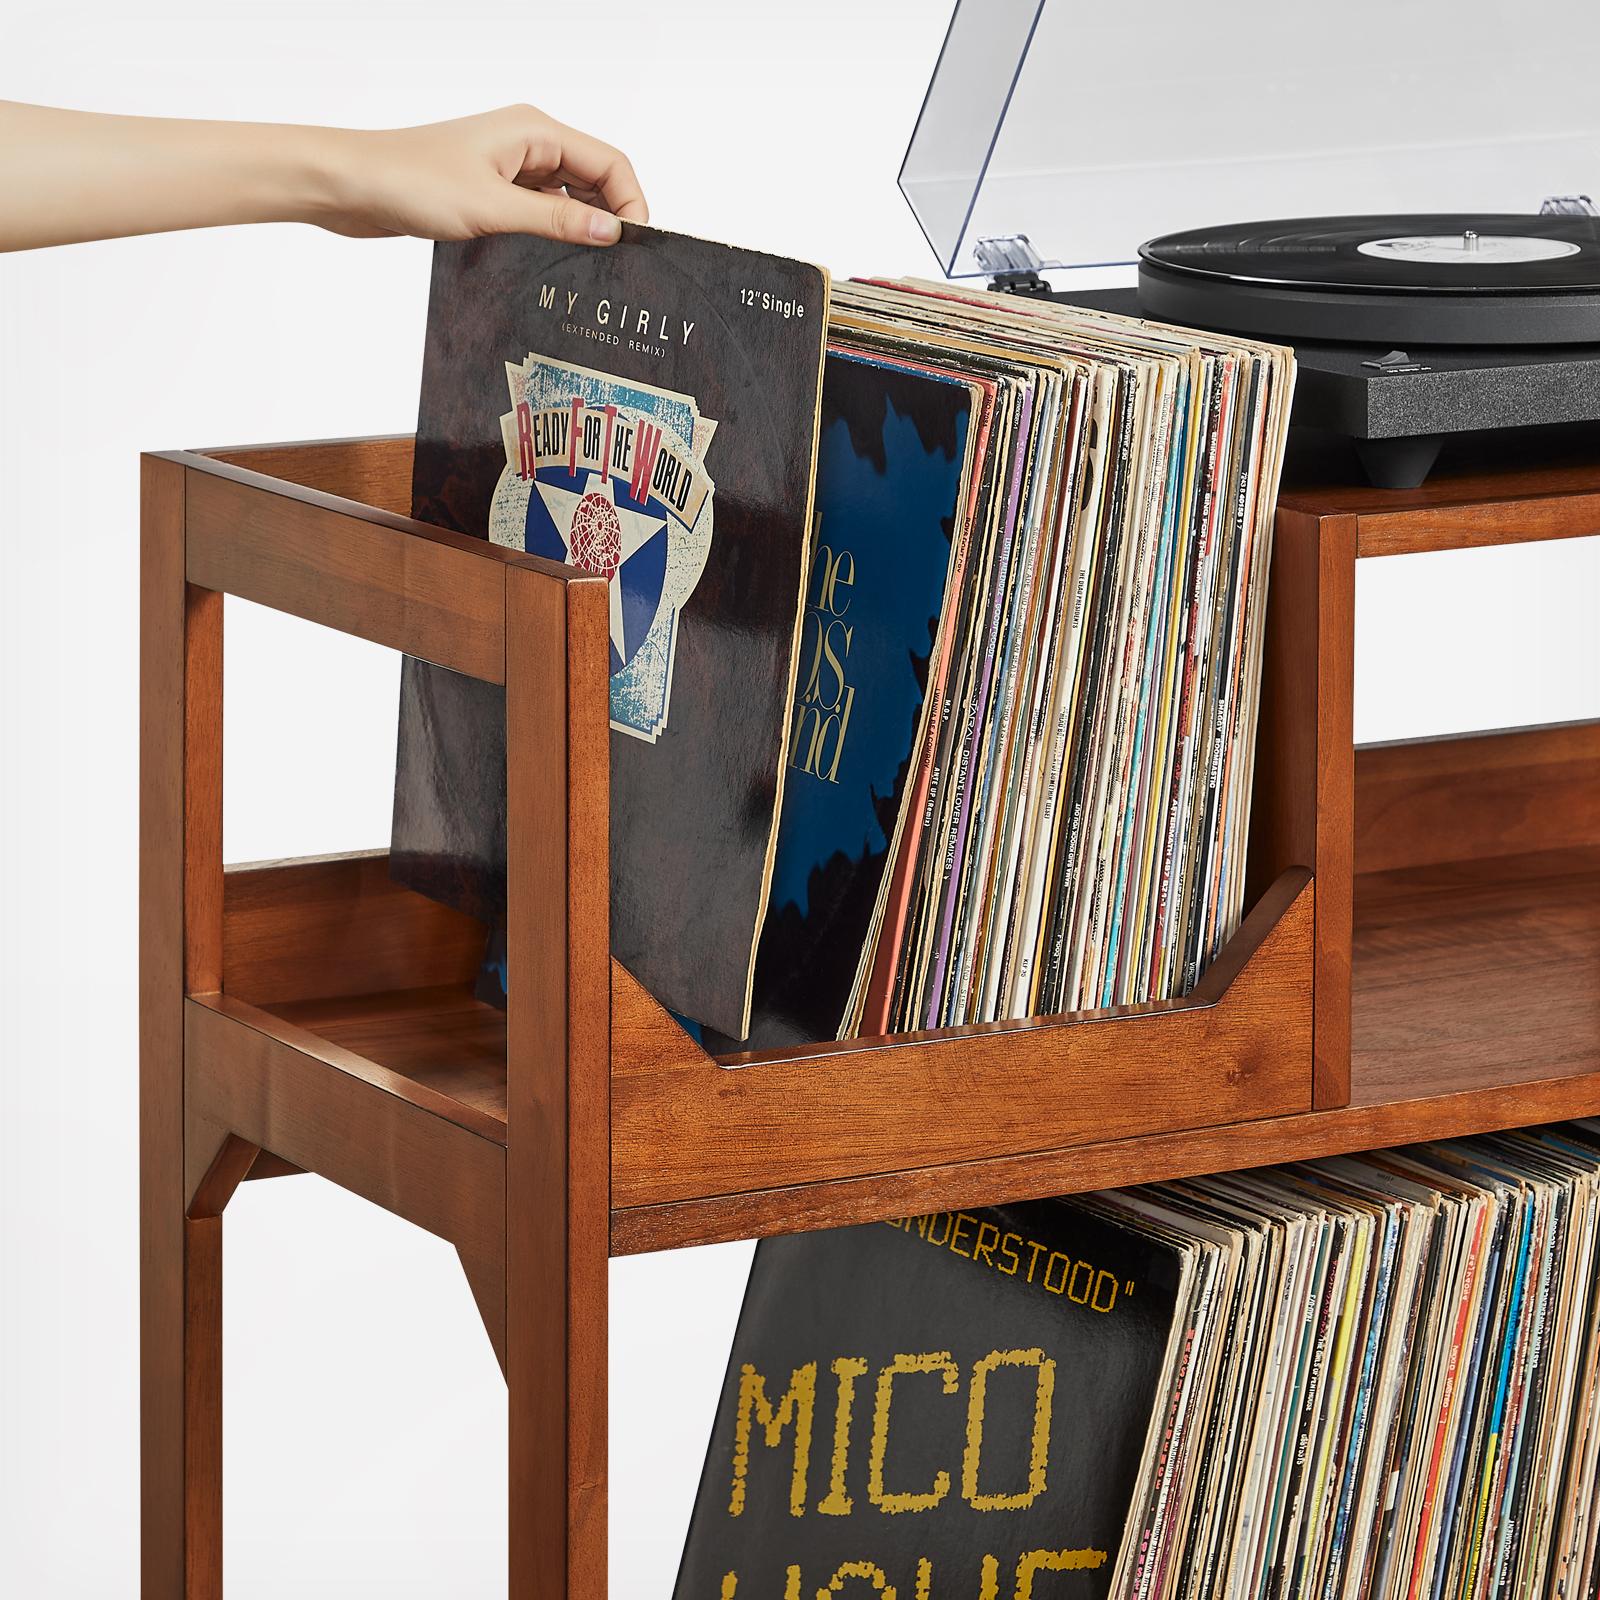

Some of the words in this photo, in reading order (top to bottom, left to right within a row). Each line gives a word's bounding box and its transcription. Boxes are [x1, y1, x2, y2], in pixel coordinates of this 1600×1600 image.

[538, 284, 579, 315] MY
[596, 299, 695, 346] GIRLY
[561, 323, 620, 346] (EXTENDED
[628, 340, 666, 358] REMIX)
[516, 401, 570, 482] READY
[568, 397, 602, 478] FOR
[600, 404, 634, 485] THE
[629, 419, 694, 514] WORLD
[1206, 430, 1218, 470] EMINEM
[1239, 471, 1247, 487] 7243
[1202, 492, 1211, 516] SING
[1200, 518, 1208, 538] FOR
[805, 511, 856, 617] he
[1197, 539, 1206, 560] THE
[1076, 580, 1084, 594] DEAD
[1192, 561, 1203, 603] MOMENT
[1020, 590, 1029, 605] AND
[1071, 595, 1082, 629] PRESIDENTS
[991, 603, 1002, 630] GOODY
[987, 630, 997, 659] GOODY
[940, 698, 951, 723] M.O.P.
[1215, 698, 1225, 731] SHAGGY
[931, 766, 941, 785] ANTE
[956, 749, 970, 790] DISTANT
[1209, 737, 1221, 788] BOOMBASTIC
[928, 786, 937, 798] UP
[923, 798, 935, 827] (Remix)
[951, 792, 963, 824] LOVER
[1071, 816, 1079, 830] YOU
[1073, 802, 1081, 816] OUT
[1068, 829, 1077, 852] KNOCK
[1165, 798, 1178, 856] AFTERMATH
[944, 827, 958, 870] REMIXES
[1063, 867, 1071, 887] MAMA
[1442, 1376, 1453, 1408] WASTED
[1502, 1519, 1514, 1560] DOCUMENT
[1532, 1334, 1542, 1368] EASTERN
[1537, 1286, 1549, 1334] CONFERENCE
[1544, 1252, 1554, 1286] RECORDS
[727, 1346, 1057, 1519] MICO
